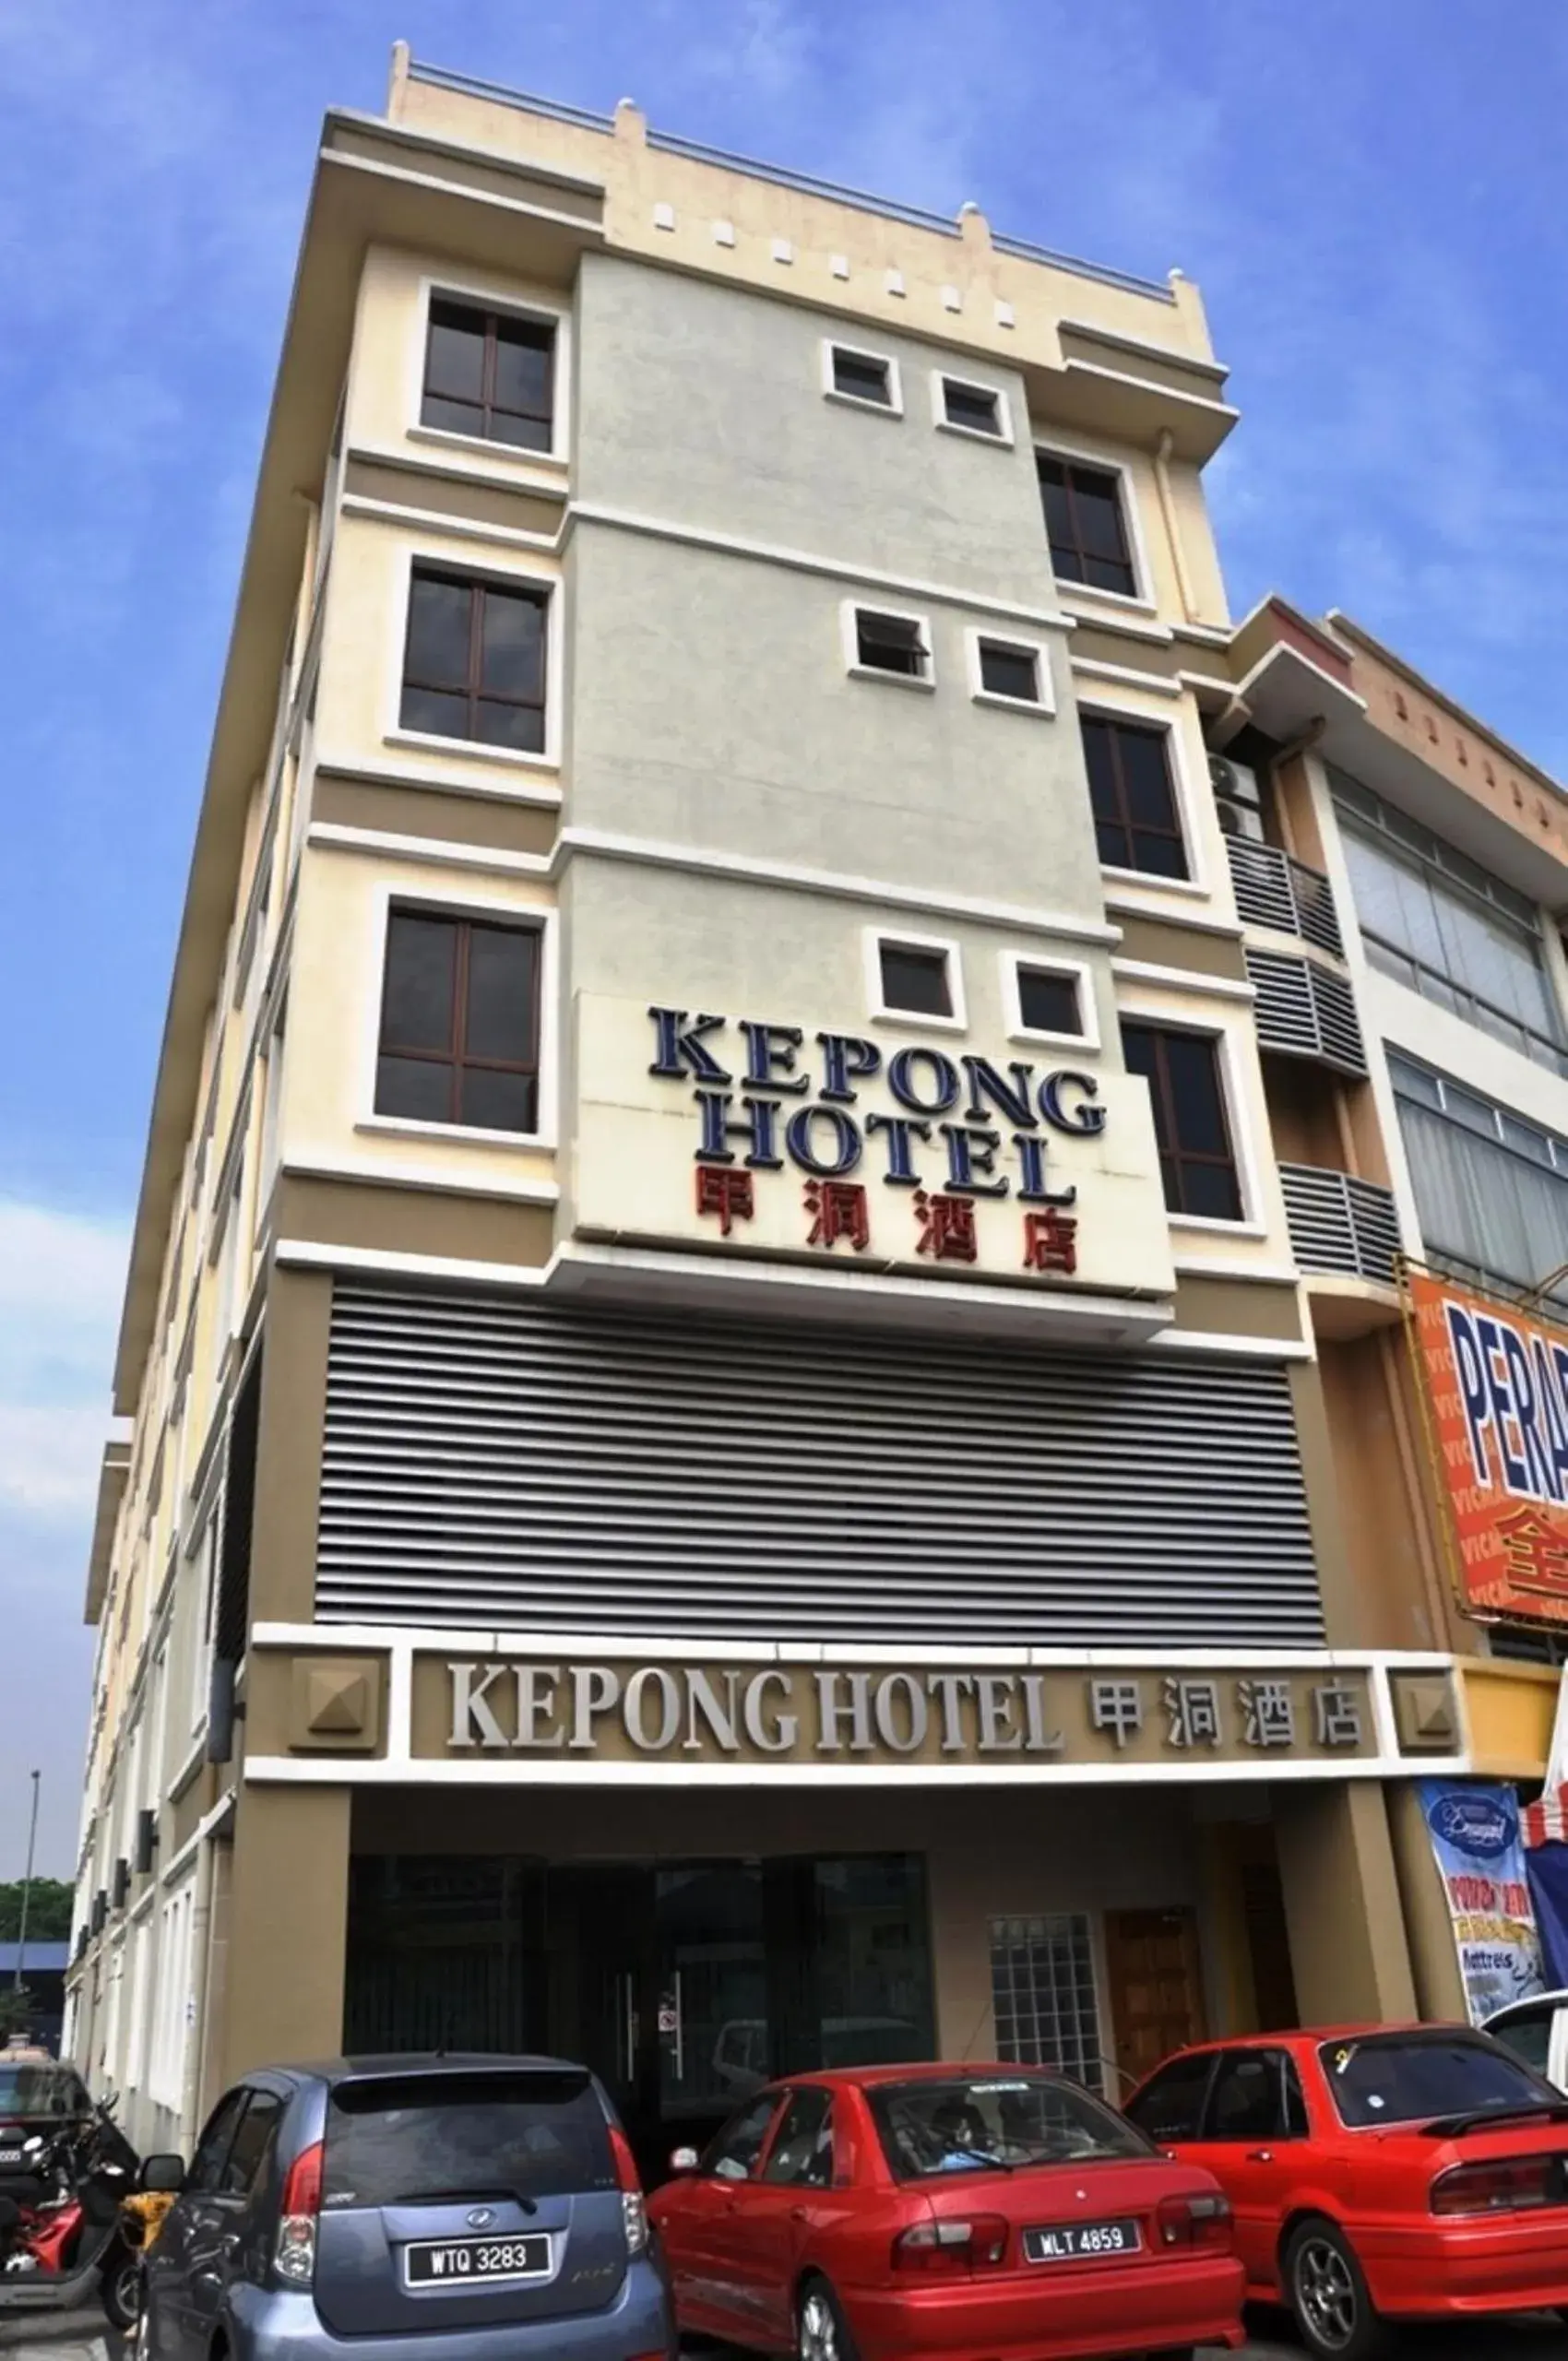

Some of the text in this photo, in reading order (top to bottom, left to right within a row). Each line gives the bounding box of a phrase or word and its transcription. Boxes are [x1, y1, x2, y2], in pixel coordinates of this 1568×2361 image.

[648, 1006, 1107, 1137] KEPONG
[694, 1089, 1077, 1207] HOTEL
[695, 1164, 1080, 1275] 甲洞酒店
[447, 1663, 1363, 1752] KEPONG HOTEL 甲洞酒店
[431, 2243, 527, 2274] WTQ 3283
[1039, 2226, 1123, 2256] WLT 4859
